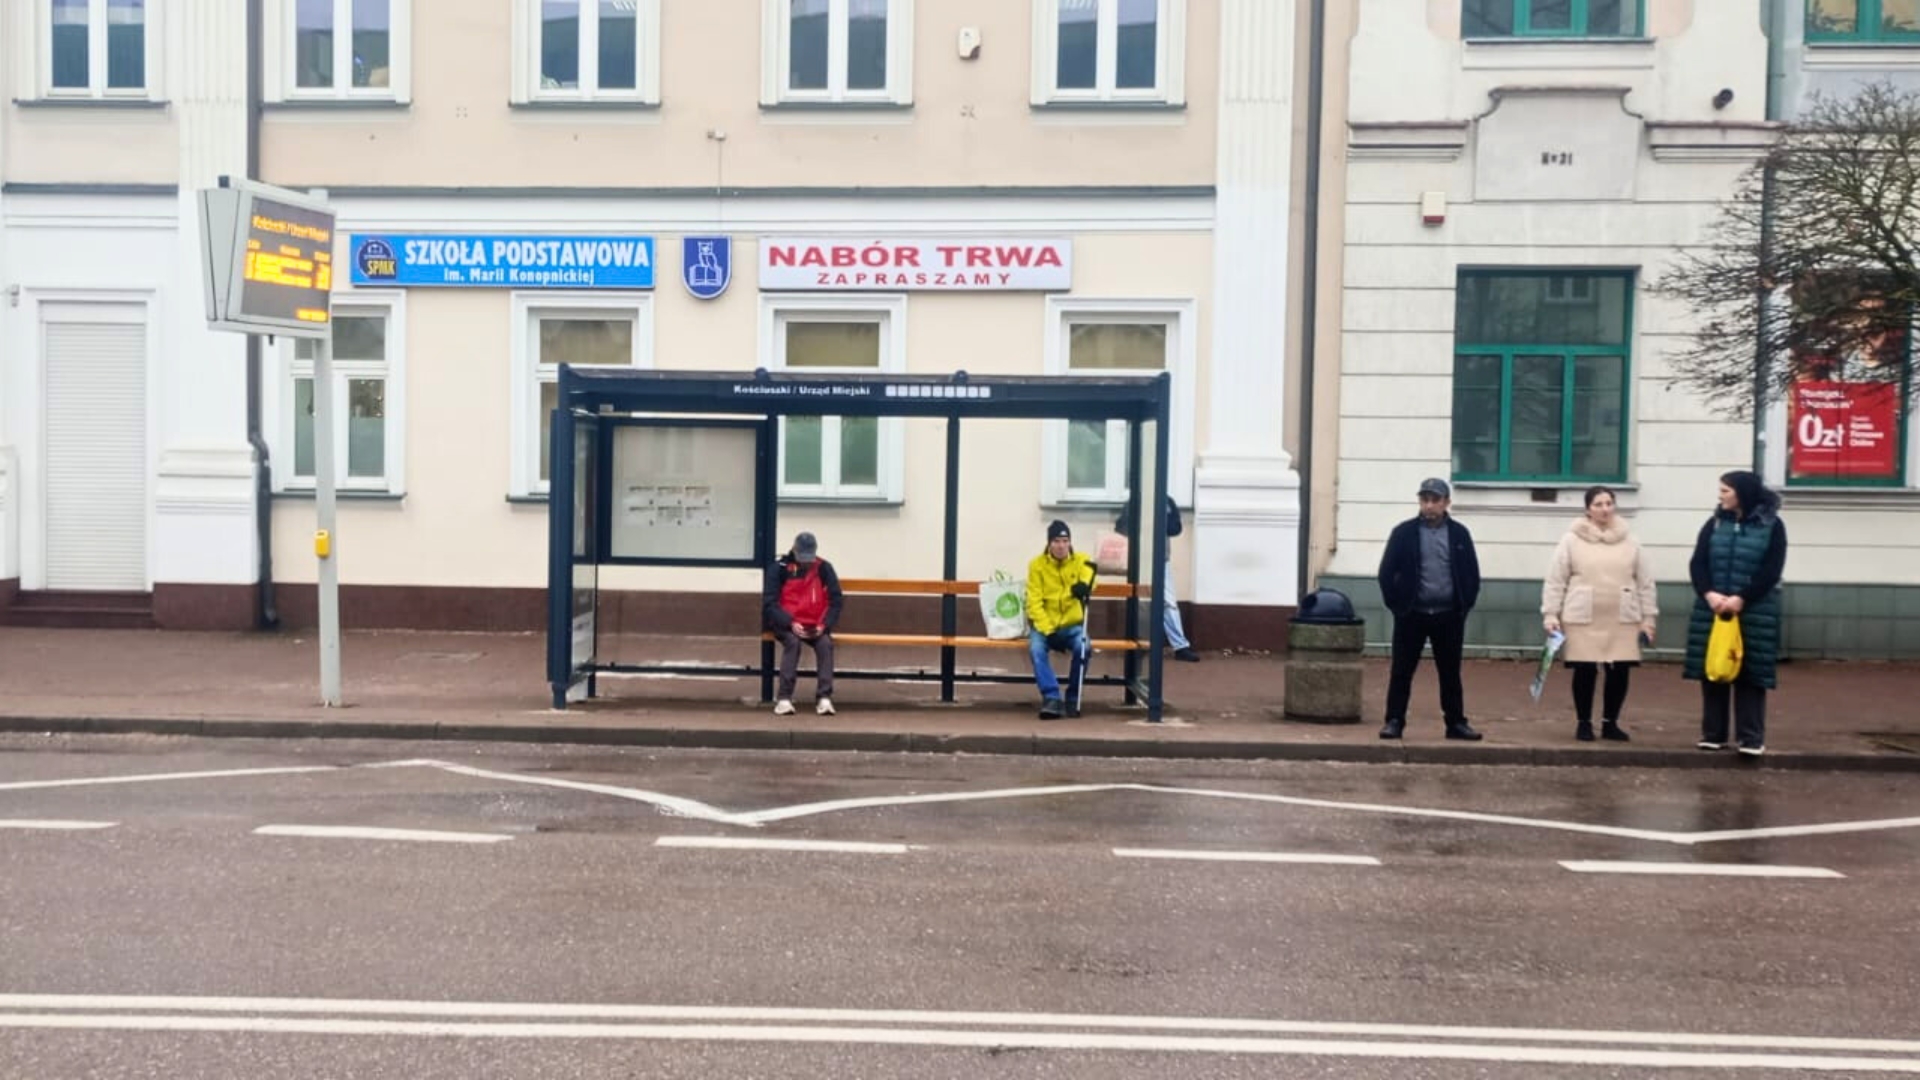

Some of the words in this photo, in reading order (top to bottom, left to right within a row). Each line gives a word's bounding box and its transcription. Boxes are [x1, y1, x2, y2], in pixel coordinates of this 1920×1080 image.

[405, 239, 486, 266] SZKOŁA
[493, 240, 650, 267] PODSTAWOWA
[769, 241, 920, 267] NABÓR
[936, 246, 1062, 267] TRWA
[510, 268, 595, 285] Konopnickiej
[817, 273, 1011, 285] ZAPRASZAMY
